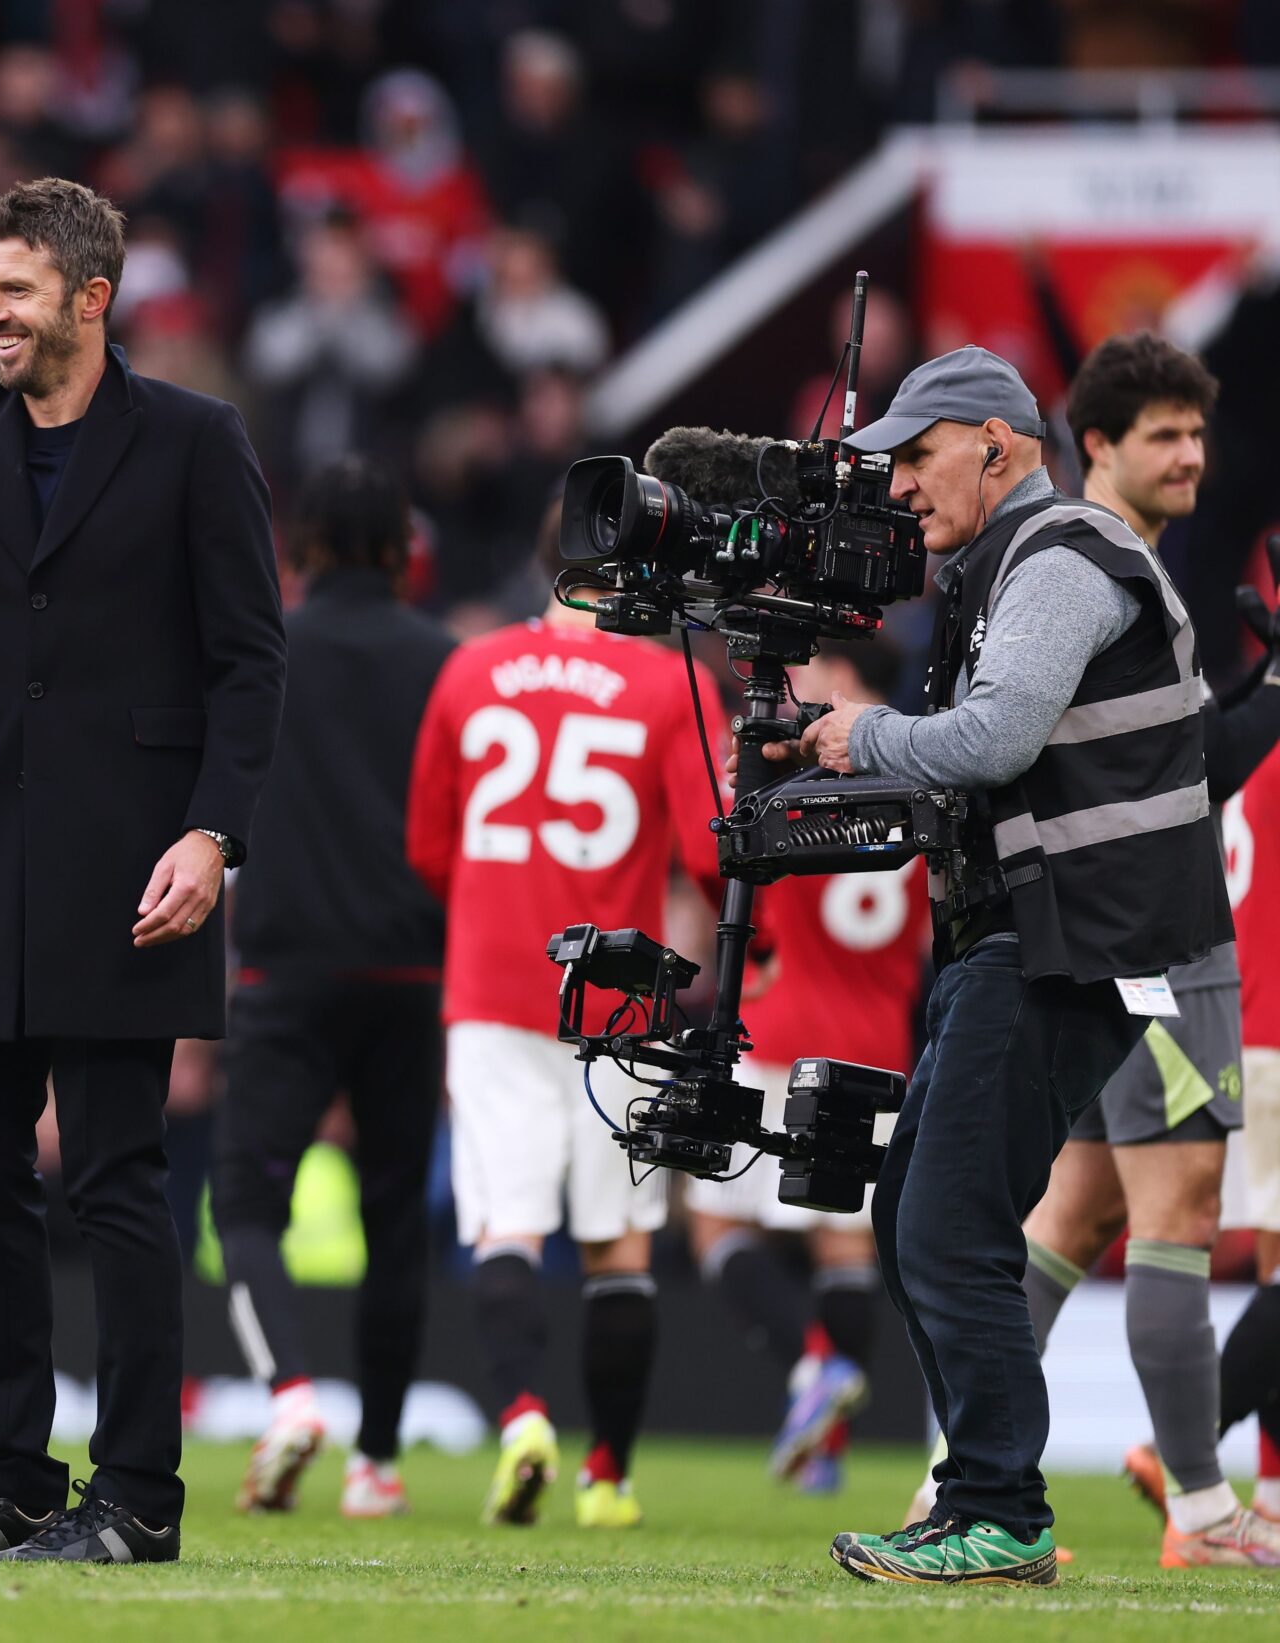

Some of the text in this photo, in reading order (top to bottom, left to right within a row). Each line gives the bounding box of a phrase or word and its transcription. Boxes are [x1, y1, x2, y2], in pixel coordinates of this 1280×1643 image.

[490, 654, 627, 709] UGARTE
[460, 704, 648, 872] 25
[802, 795, 839, 805] STEADICAM
[1016, 1550, 1057, 1577] SALOMO
